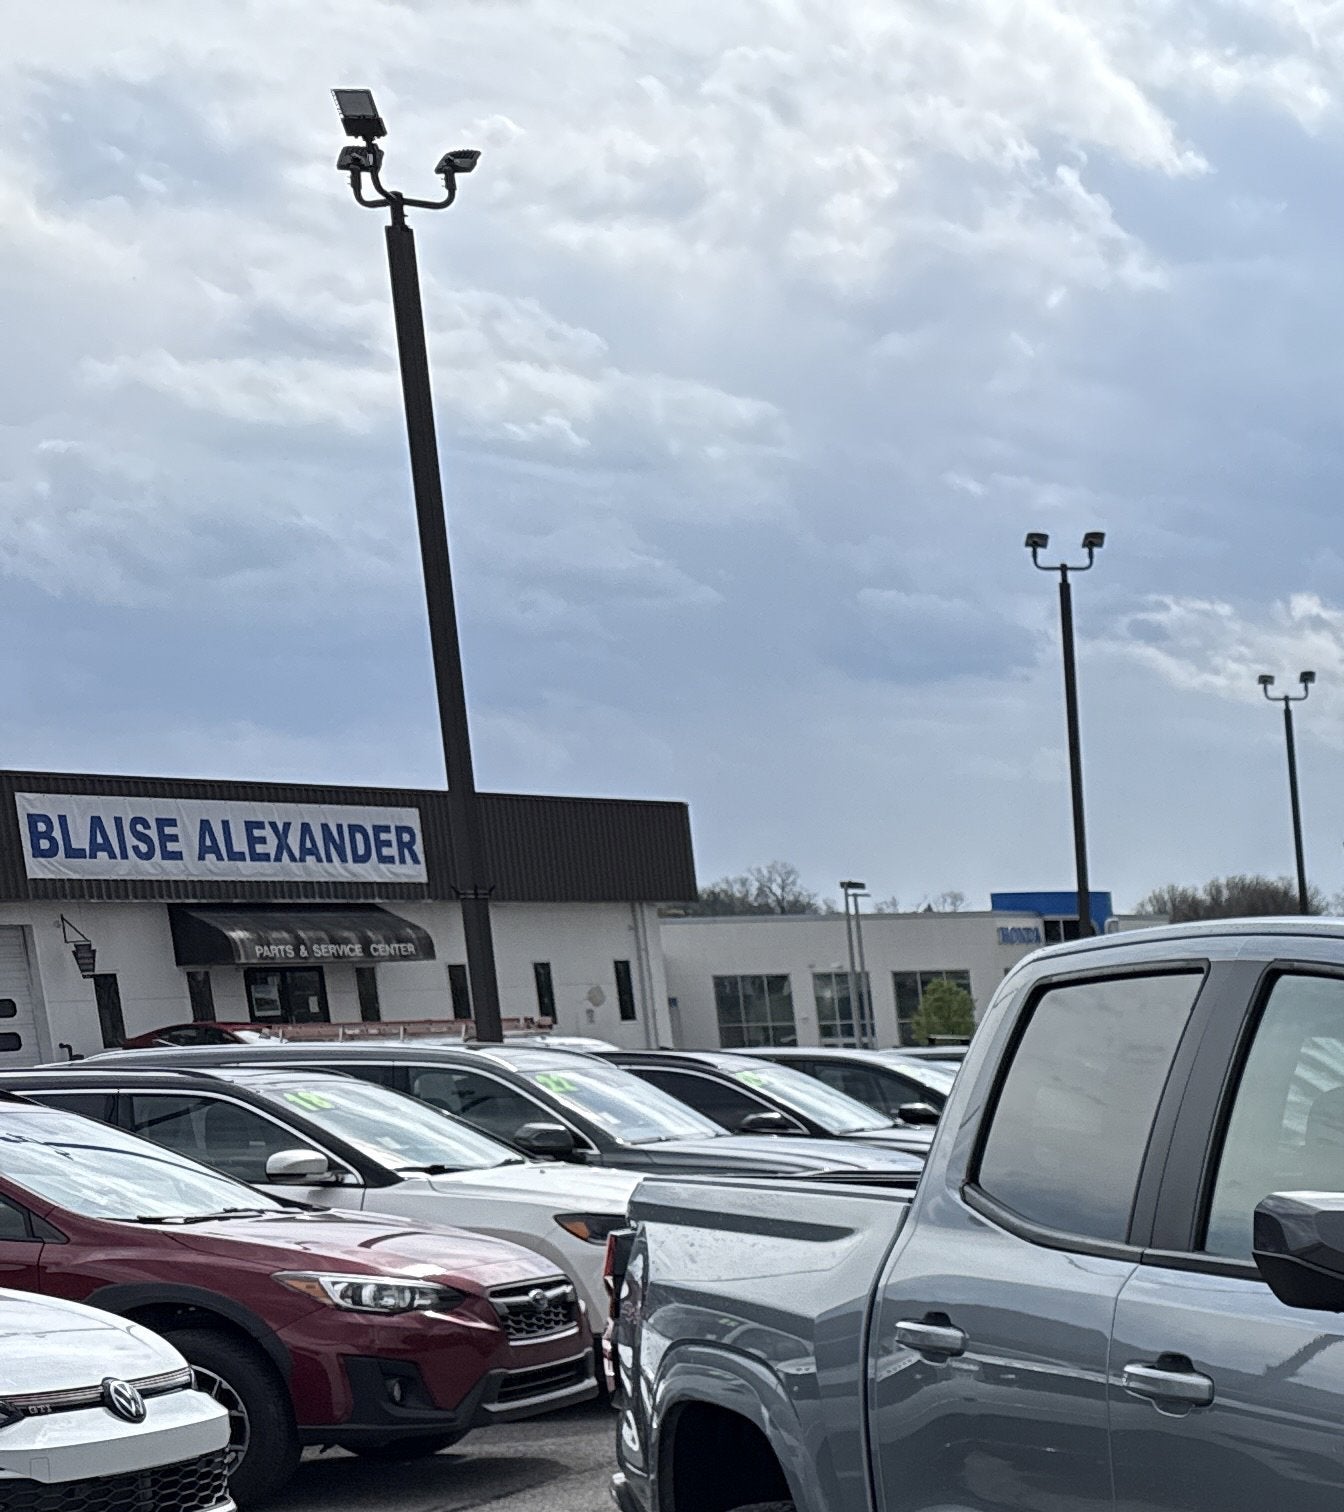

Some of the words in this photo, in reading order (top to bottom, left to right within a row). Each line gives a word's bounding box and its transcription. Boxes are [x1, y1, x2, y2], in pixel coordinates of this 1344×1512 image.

[26, 812, 184, 861] BLAISE
[197, 818, 421, 866] ALEXANDER
[255, 945, 294, 957] PARTS
[300, 945, 309, 957] &
[312, 944, 364, 957] SERVICE
[370, 943, 416, 956] CENTER
[28, 1404, 52, 1414] GTI
